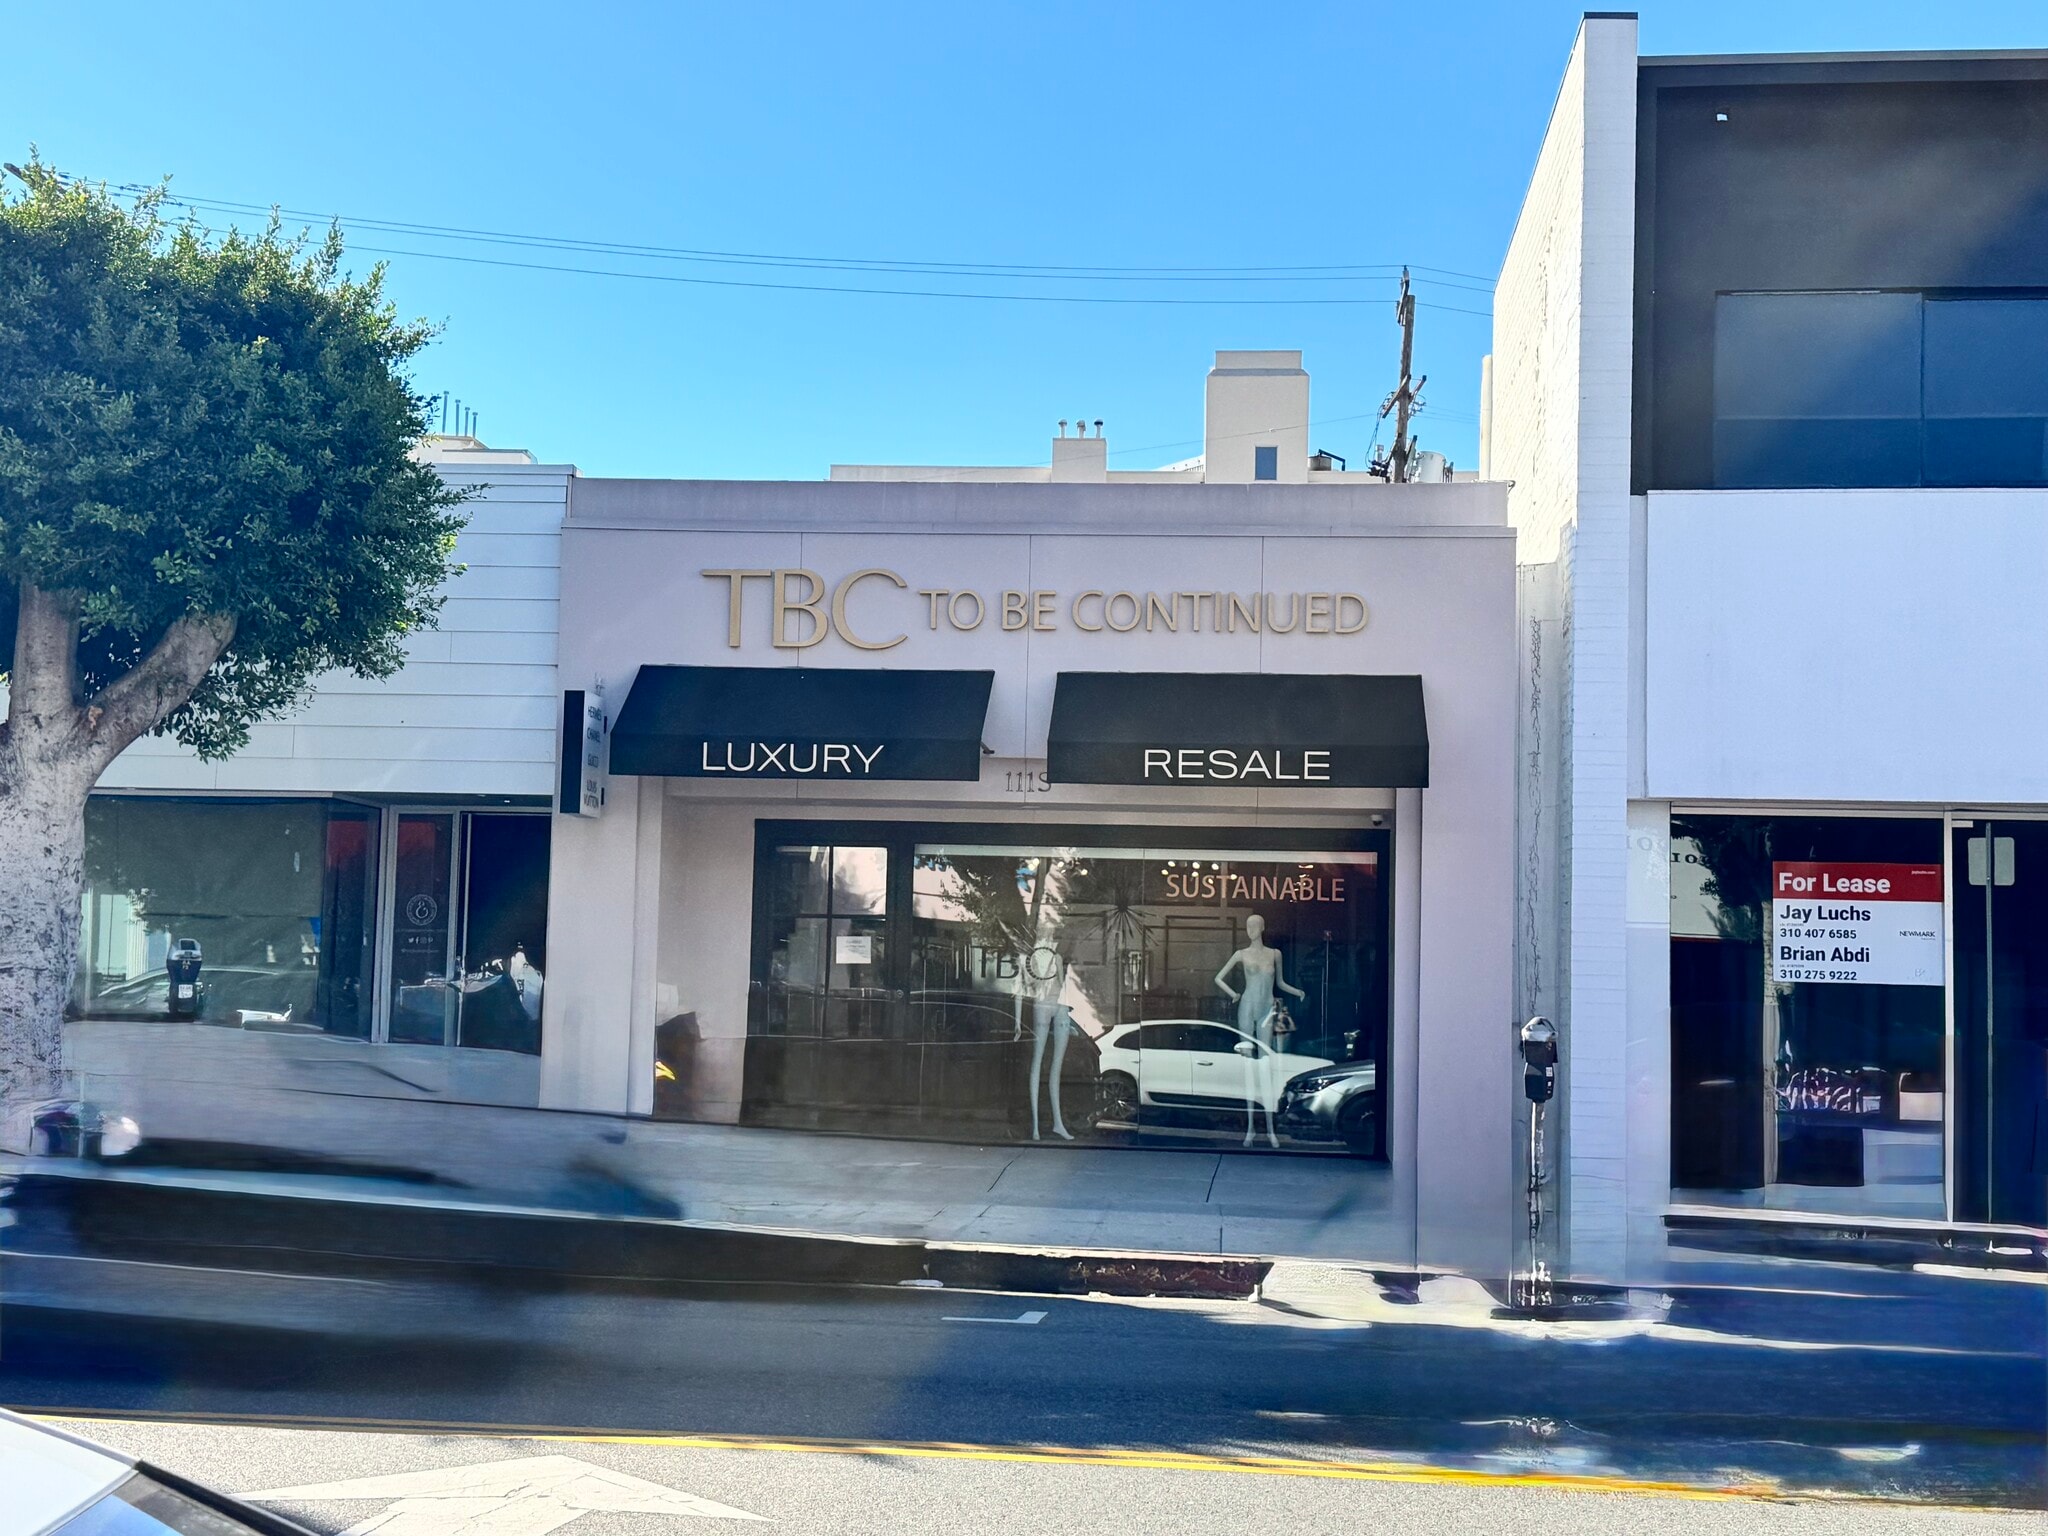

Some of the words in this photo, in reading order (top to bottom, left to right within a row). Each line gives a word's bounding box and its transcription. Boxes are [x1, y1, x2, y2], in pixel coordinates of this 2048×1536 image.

[701, 568, 908, 651] TBC
[919, 588, 986, 631] TO
[1000, 590, 1057, 632] BE
[1072, 590, 1370, 635] CONTINUED
[702, 741, 885, 774] LUXURY
[1144, 748, 1331, 781] RESALE
[1166, 874, 1346, 902] SUSTAINABLE
[1779, 872, 1817, 892] For
[1822, 873, 1891, 894] Lease
[1780, 904, 1813, 924] Jay
[1817, 905, 1872, 922] Luchs
[1780, 928, 1801, 938] 310
[1804, 929, 1825, 939] 407
[1828, 929, 1857, 939] 6585
[1899, 930, 1936, 938] NEWMARK
[970, 946, 1058, 980] TBC
[1780, 945, 1826, 962] Brian
[1830, 947, 1870, 963] Abdi
[1780, 969, 1801, 979] 310
[1804, 970, 1826, 980] 275
[1829, 971, 1858, 981] 9222
